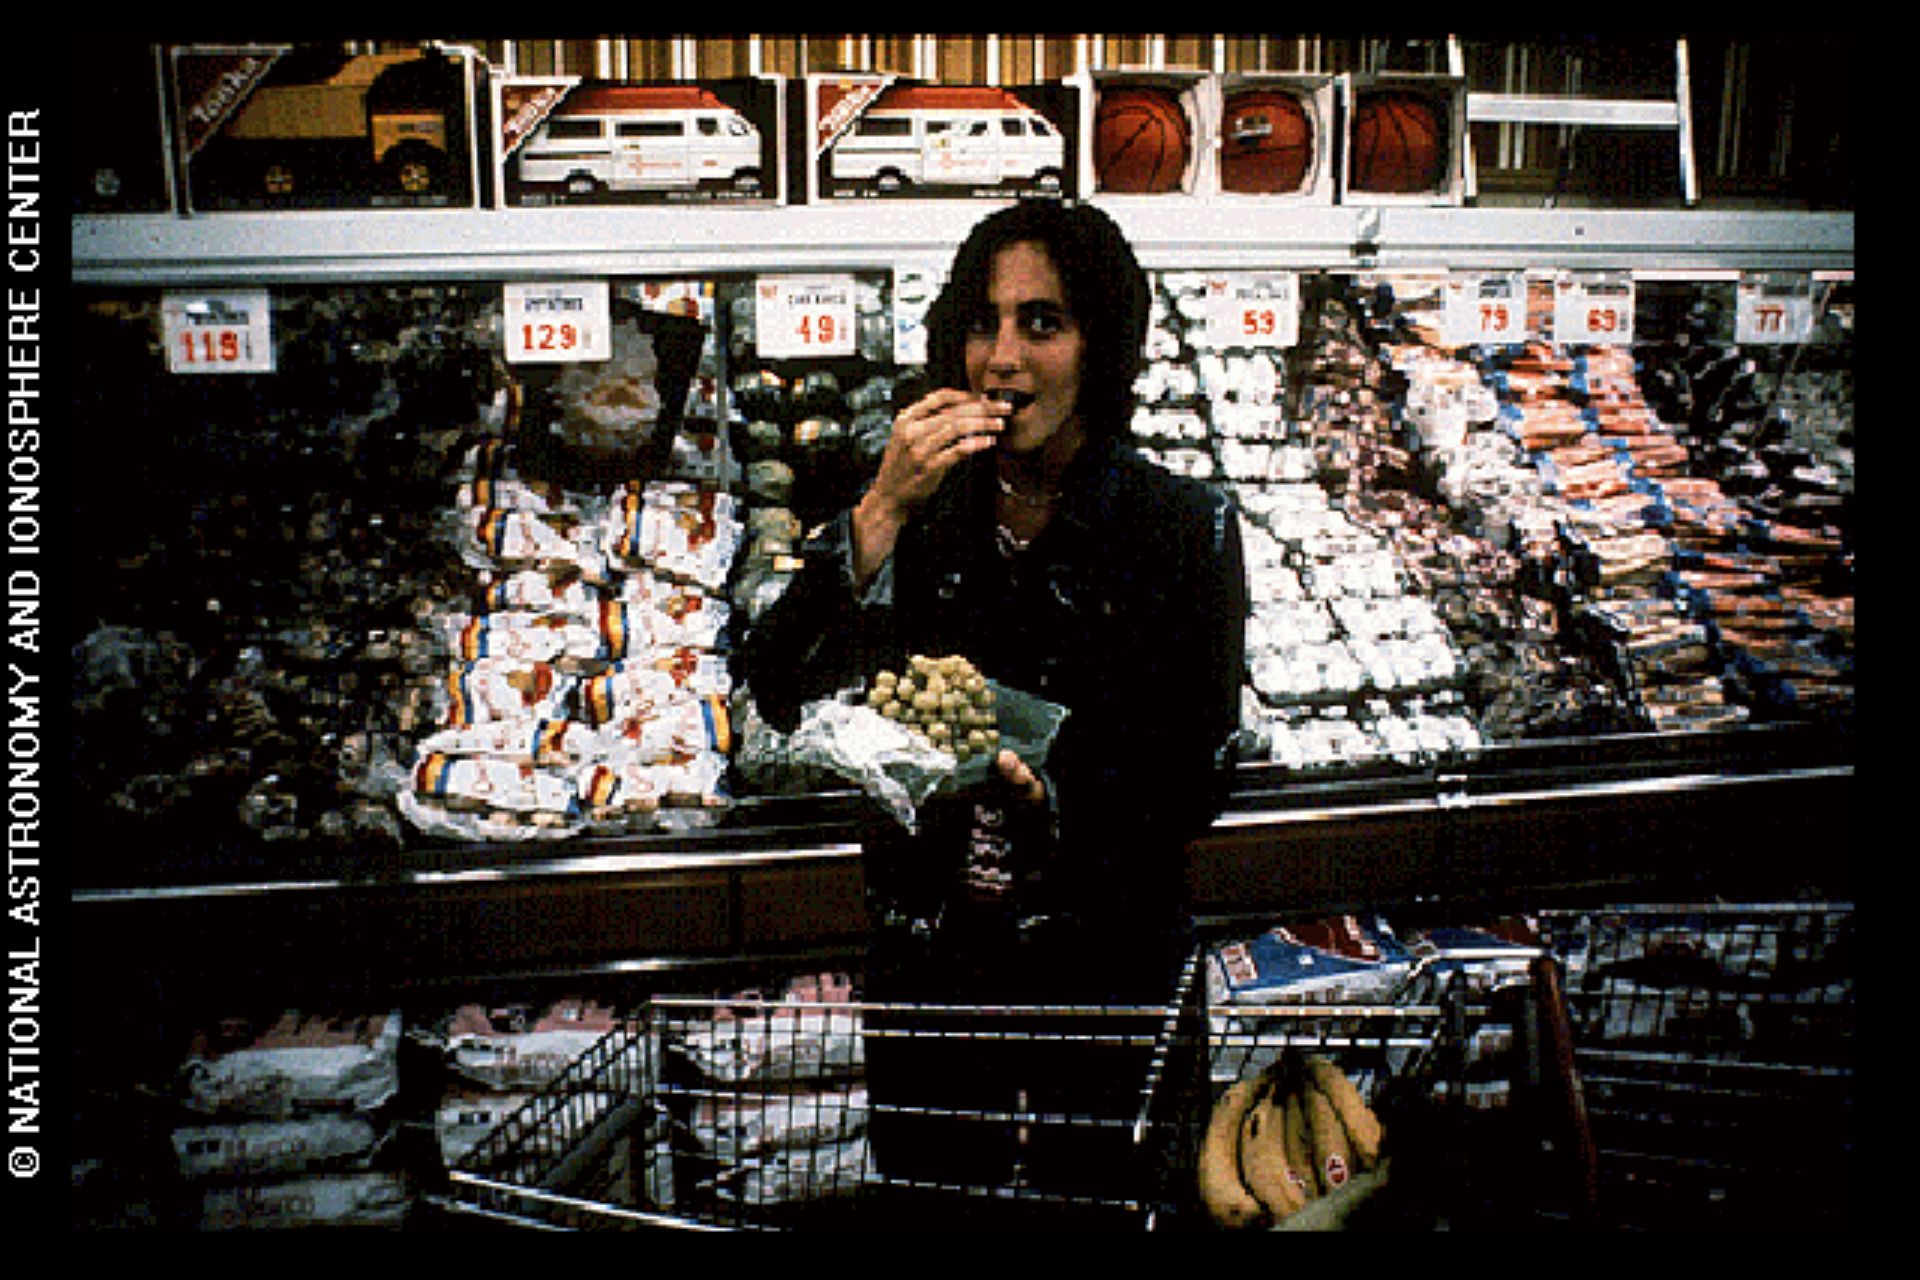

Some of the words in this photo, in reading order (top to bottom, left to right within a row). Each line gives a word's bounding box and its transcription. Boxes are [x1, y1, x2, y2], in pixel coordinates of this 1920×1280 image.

[795, 315, 835, 344] 49
[1755, 304, 1784, 331] 77
[523, 324, 577, 350] 129
